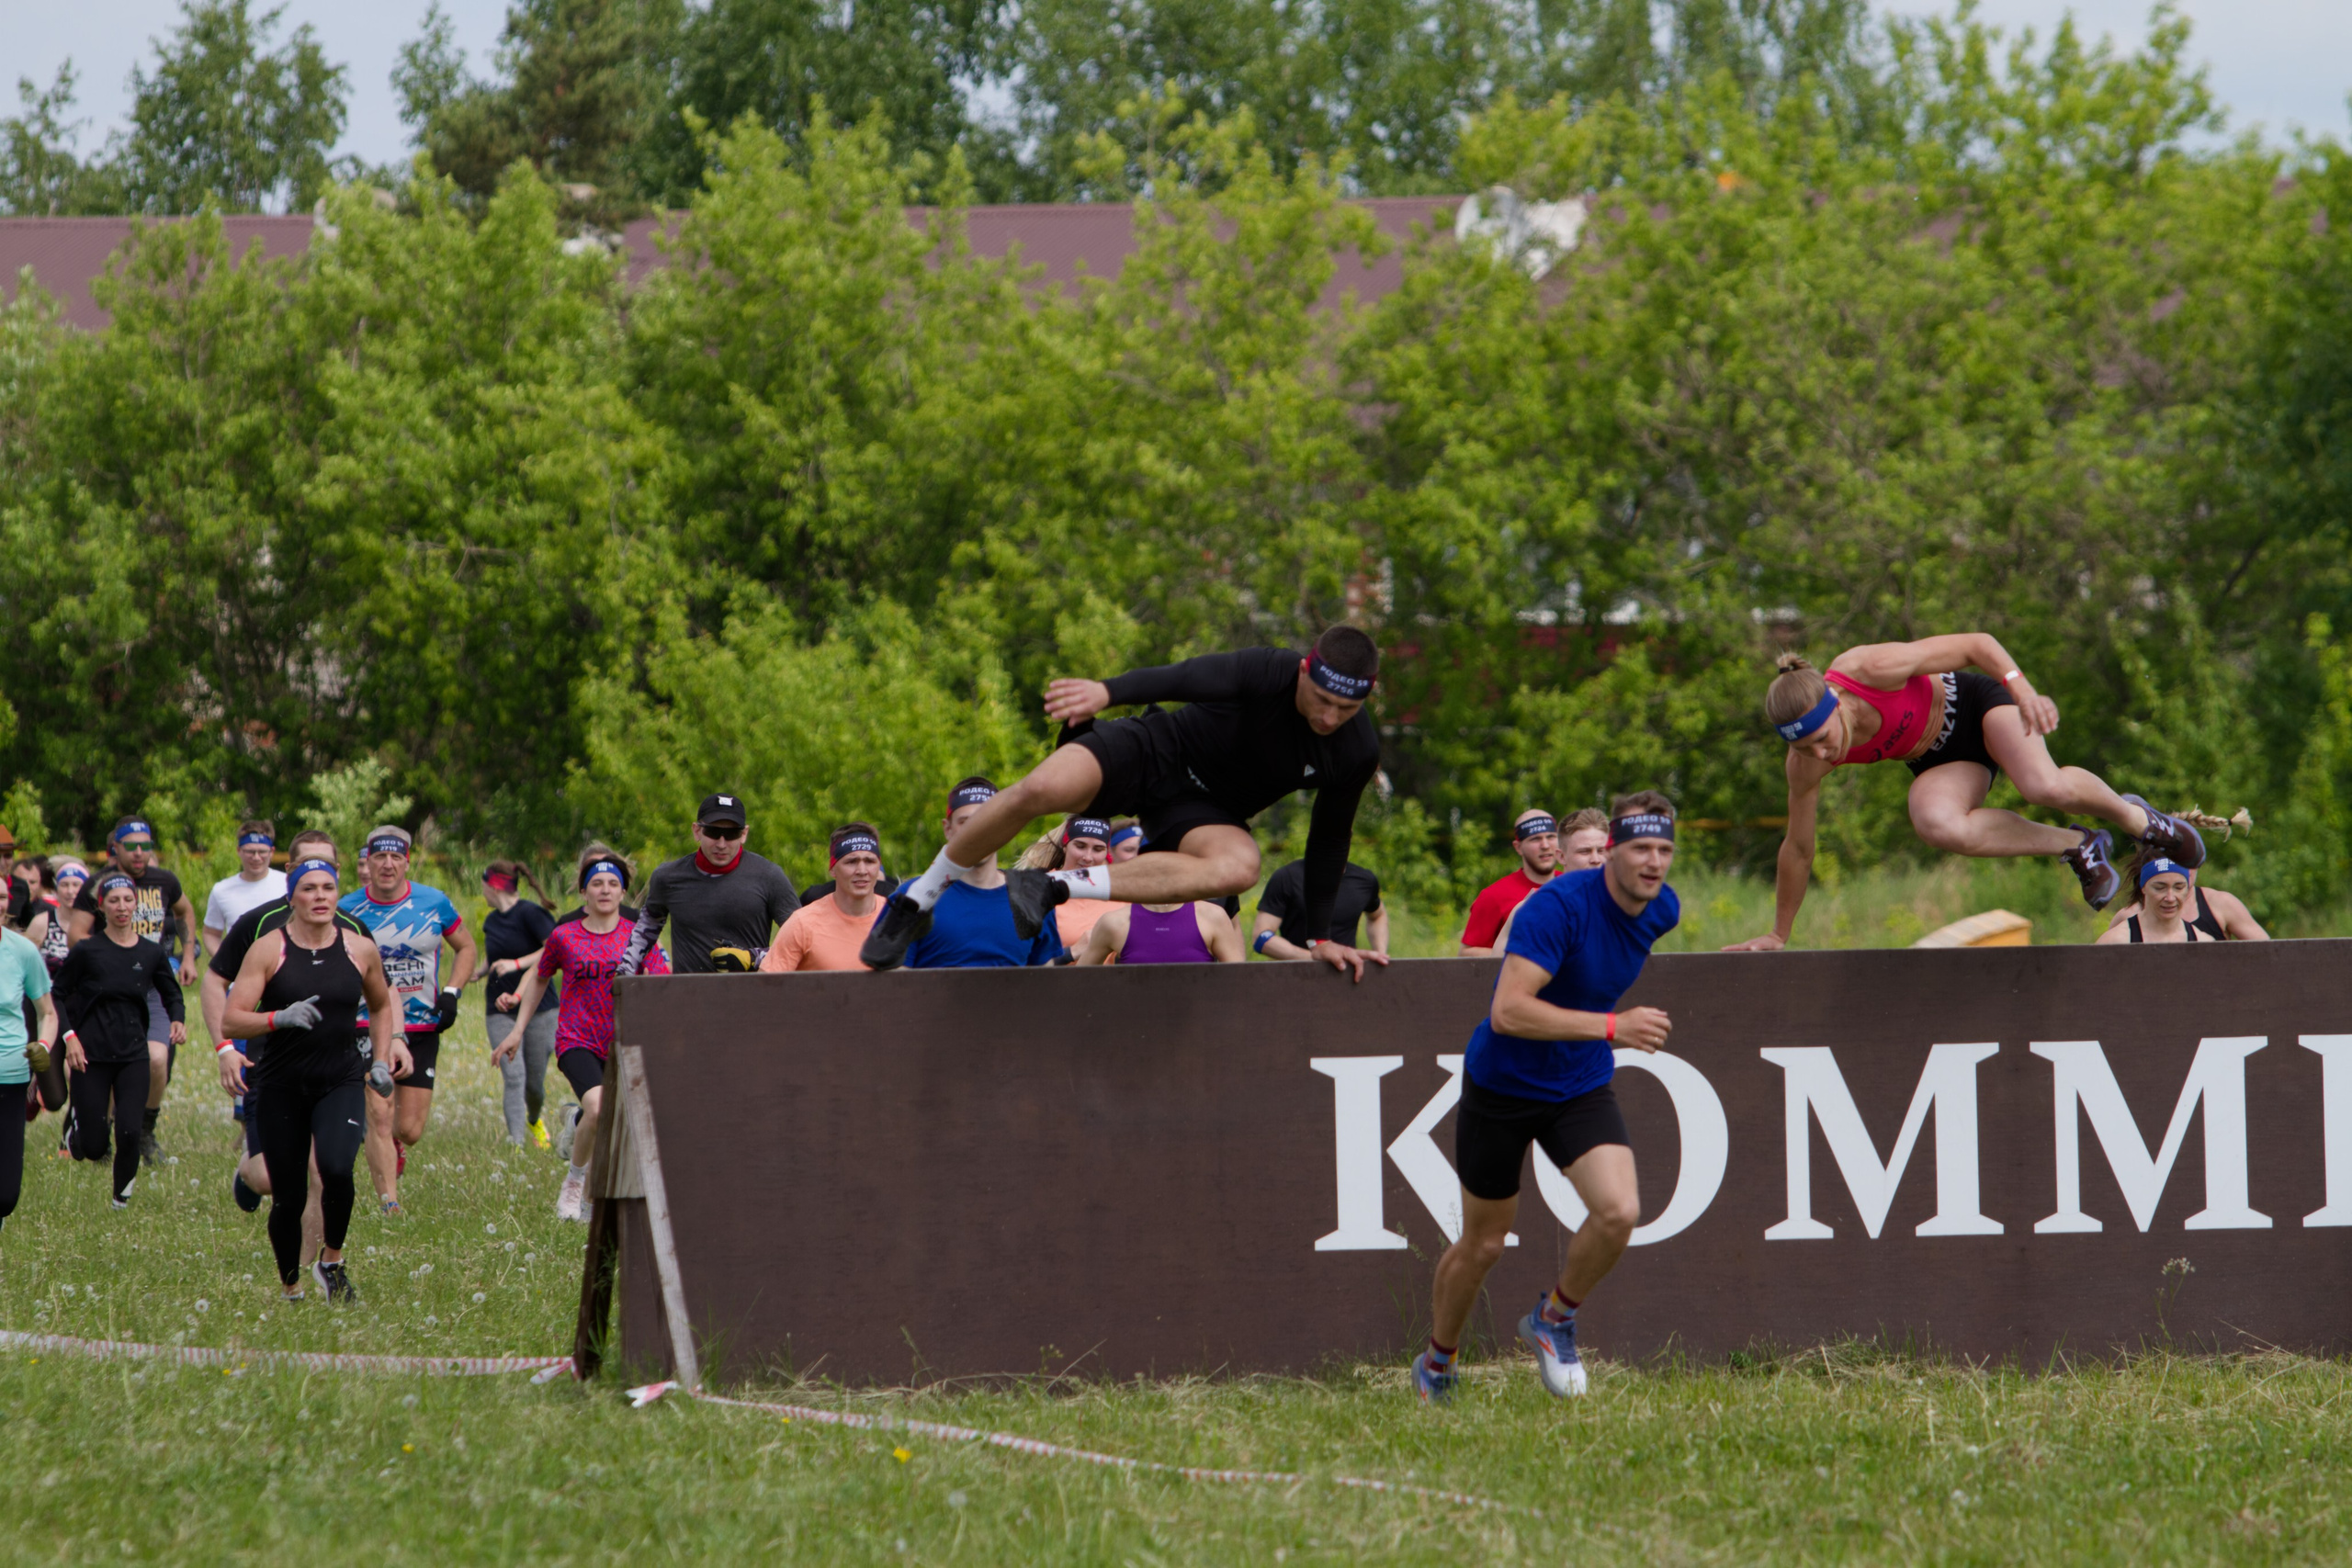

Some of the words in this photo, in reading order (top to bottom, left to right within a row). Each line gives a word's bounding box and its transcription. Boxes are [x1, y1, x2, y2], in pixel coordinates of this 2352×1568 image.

[1320, 665, 1355, 685] РОДЕО
[1326, 681, 1354, 695] 2756
[1883, 709, 1914, 750] asics
[958, 787, 989, 796] РОДЕО
[1621, 815, 1658, 827] РОДЕО
[1082, 826, 1103, 835] 2728
[1633, 824, 1661, 834] 2749
[841, 837, 869, 847] РОДЕО
[851, 843, 872, 852] 2729
[390, 970, 425, 978] UNNING
